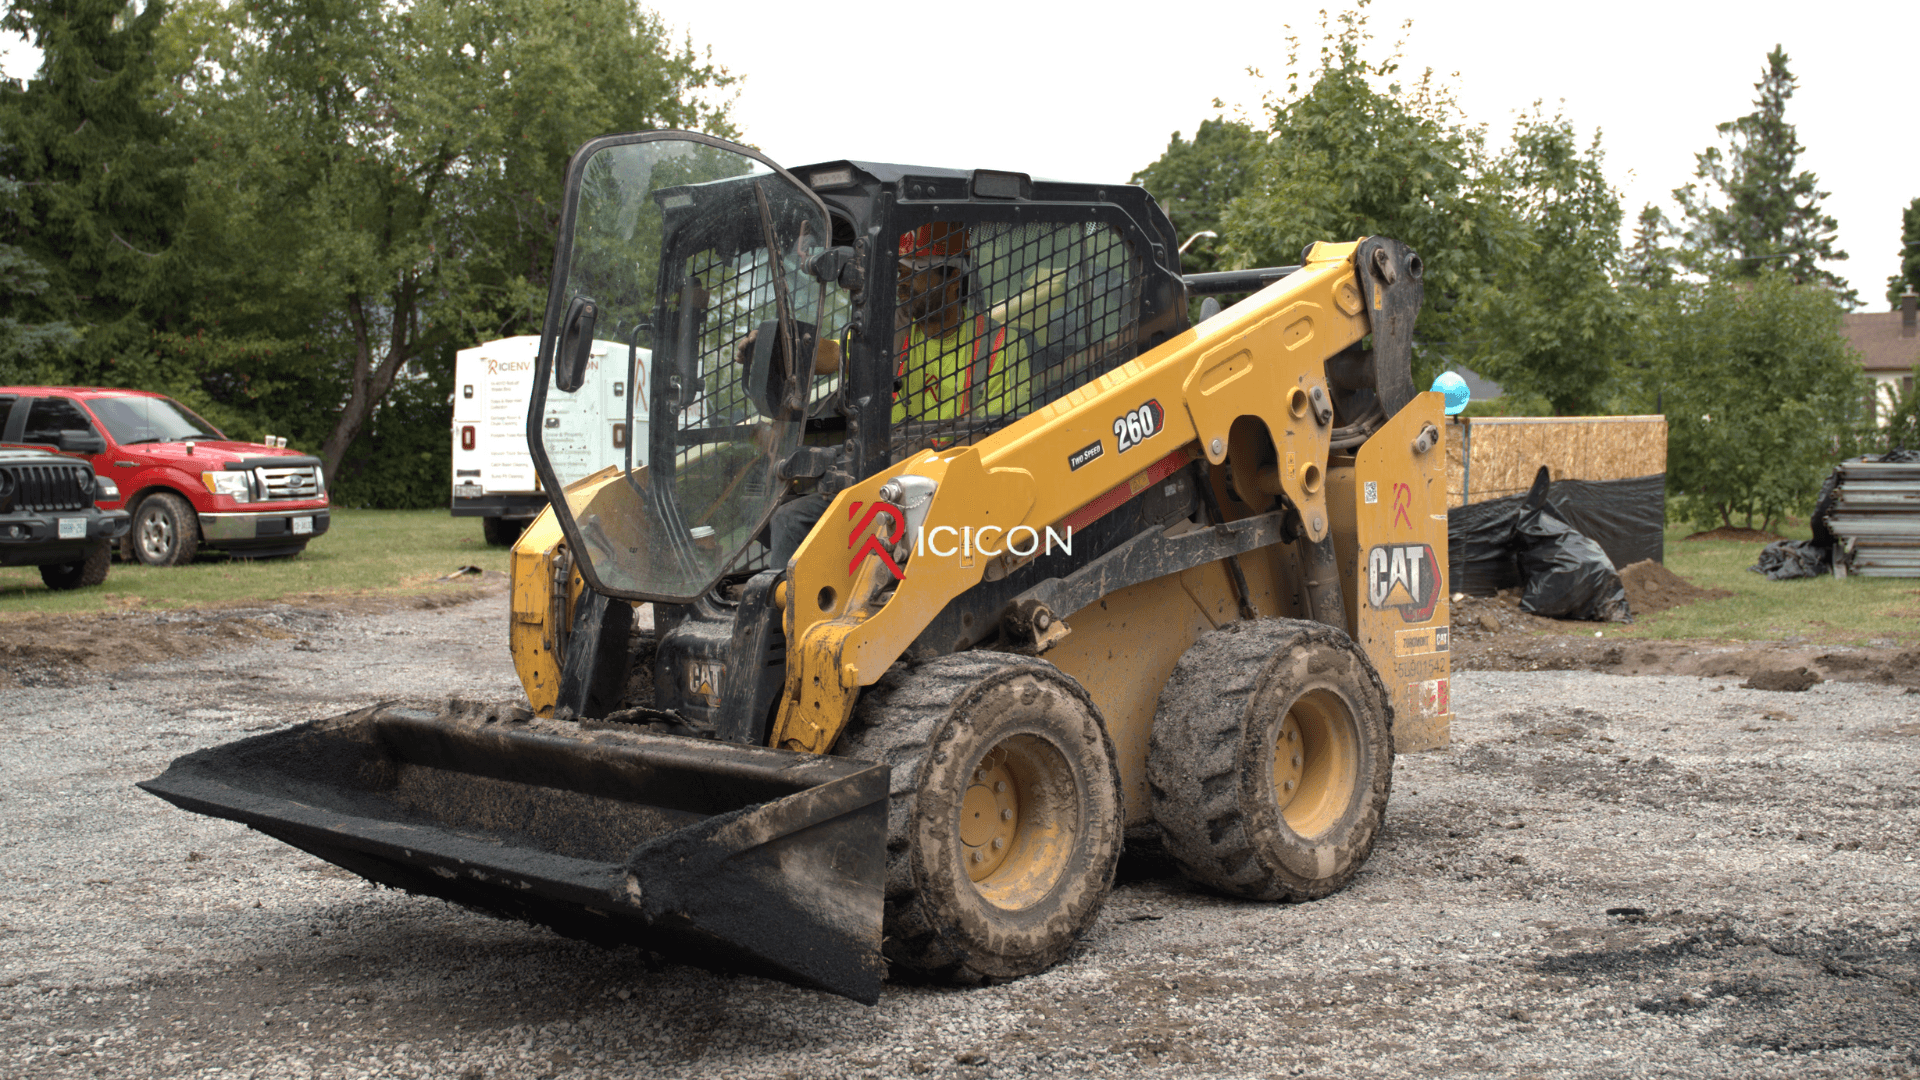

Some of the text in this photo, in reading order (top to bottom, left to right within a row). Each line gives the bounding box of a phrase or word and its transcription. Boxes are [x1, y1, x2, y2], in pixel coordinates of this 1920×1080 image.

[1114, 405, 1154, 451] 260
[1369, 546, 1424, 607] CAT
[1436, 633, 1447, 645] CAT
[689, 662, 721, 698] CAT
